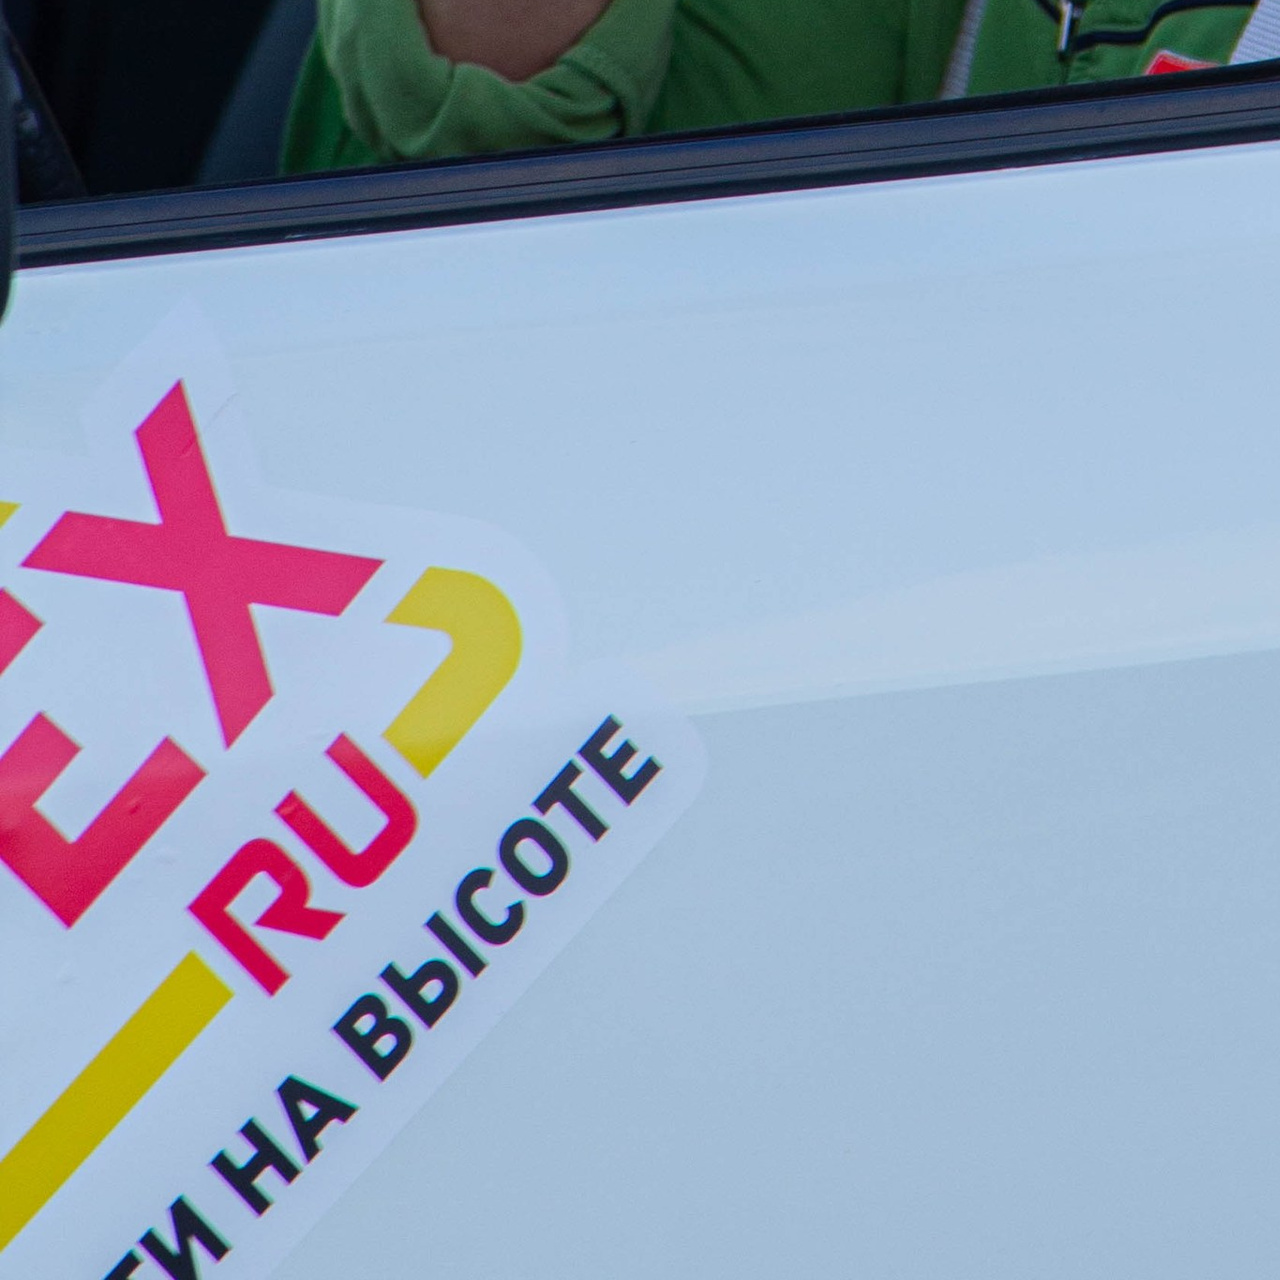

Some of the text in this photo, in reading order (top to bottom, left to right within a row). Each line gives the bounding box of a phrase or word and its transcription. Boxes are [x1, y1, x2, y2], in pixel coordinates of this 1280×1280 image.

[186, 732, 419, 997] RU
[210, 1075, 358, 1217] НА
[332, 717, 662, 1082] ВЫСОТЕ
